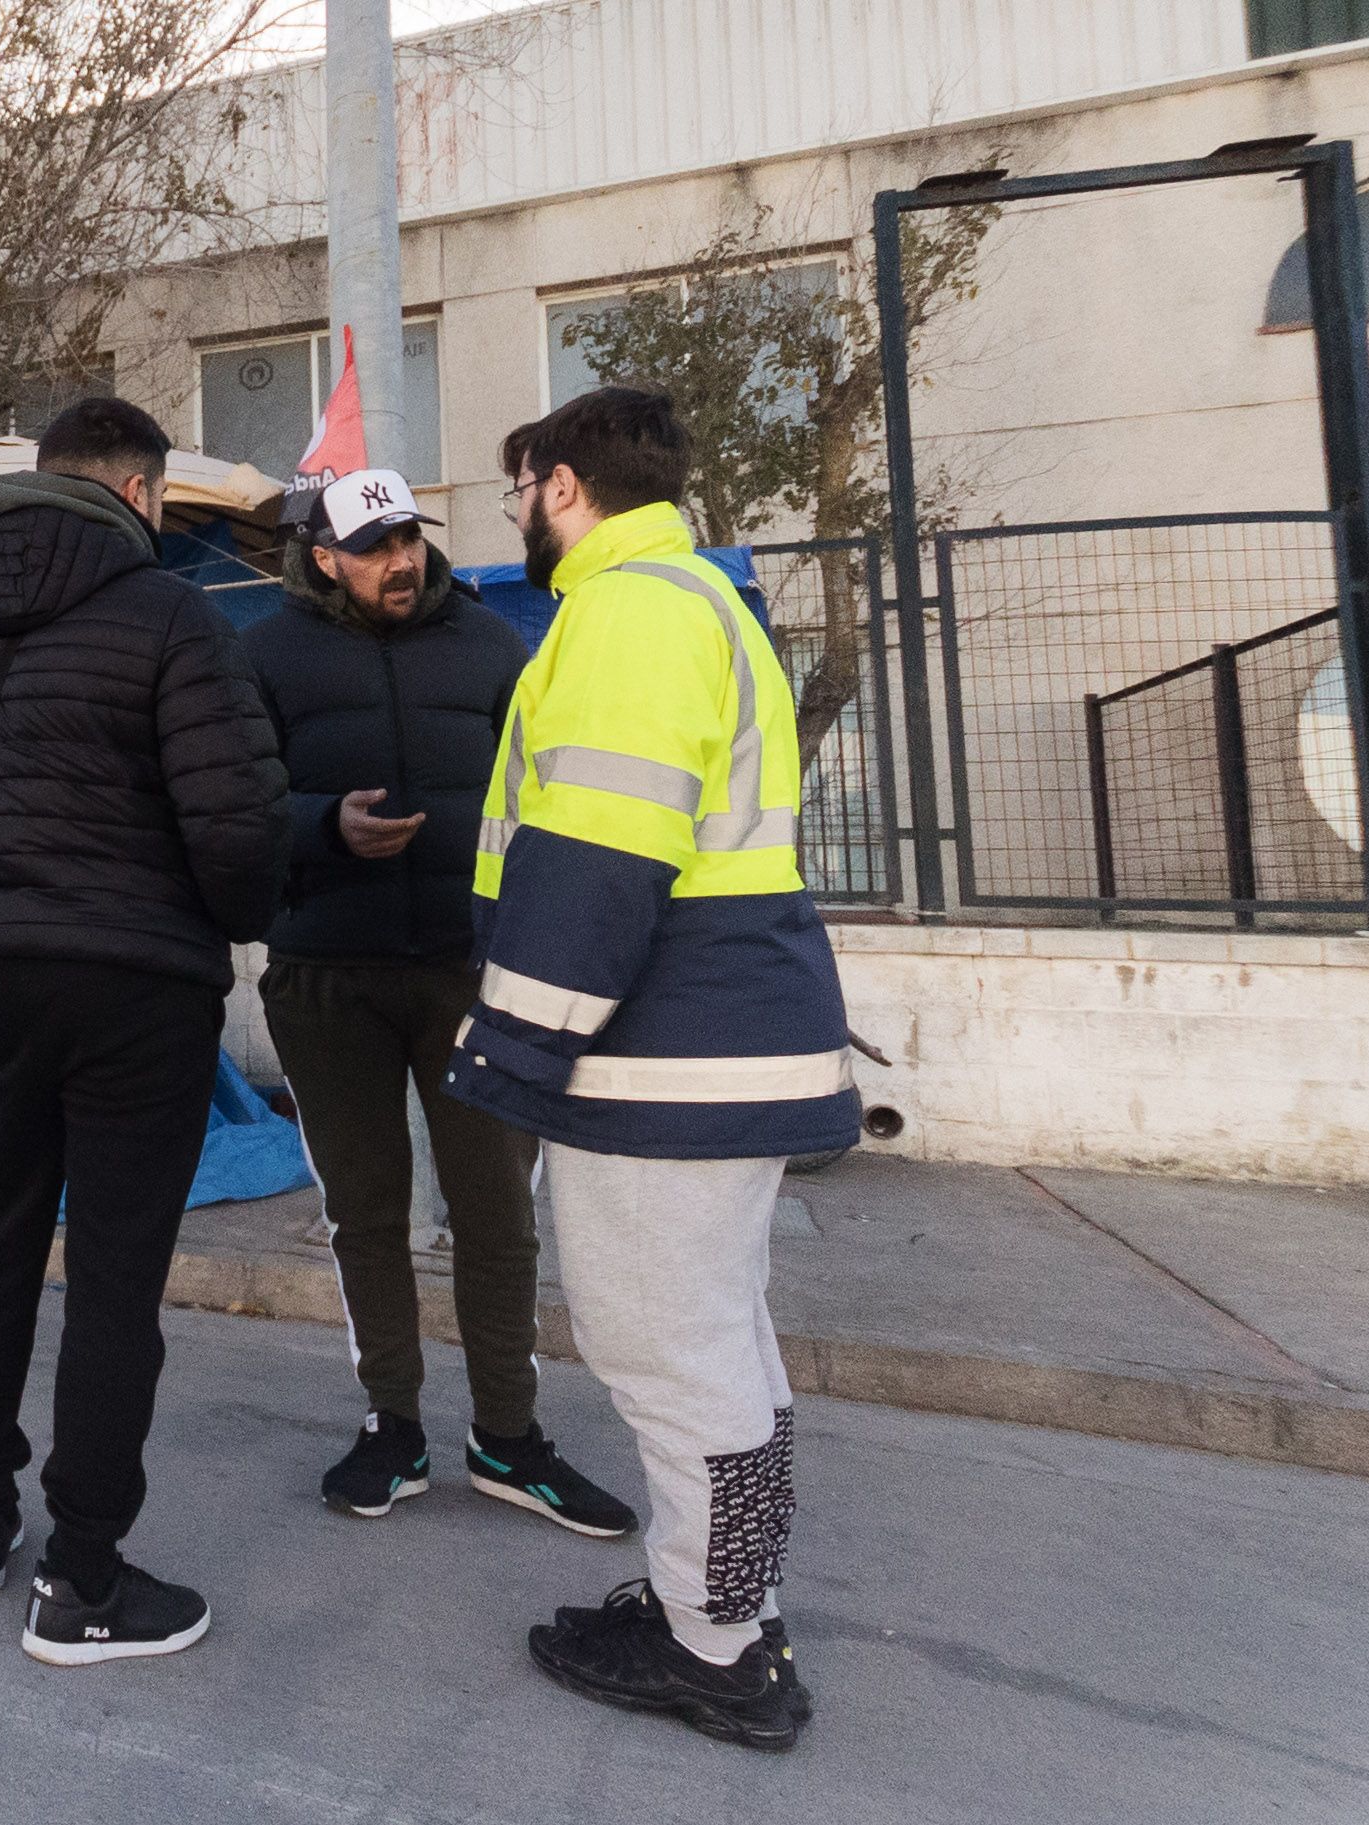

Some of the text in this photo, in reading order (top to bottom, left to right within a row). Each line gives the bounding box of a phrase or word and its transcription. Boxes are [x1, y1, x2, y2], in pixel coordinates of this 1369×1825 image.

[361, 482, 394, 509] NY
[33, 1577, 53, 1597] FILA
[85, 1627, 110, 1638] FILA
